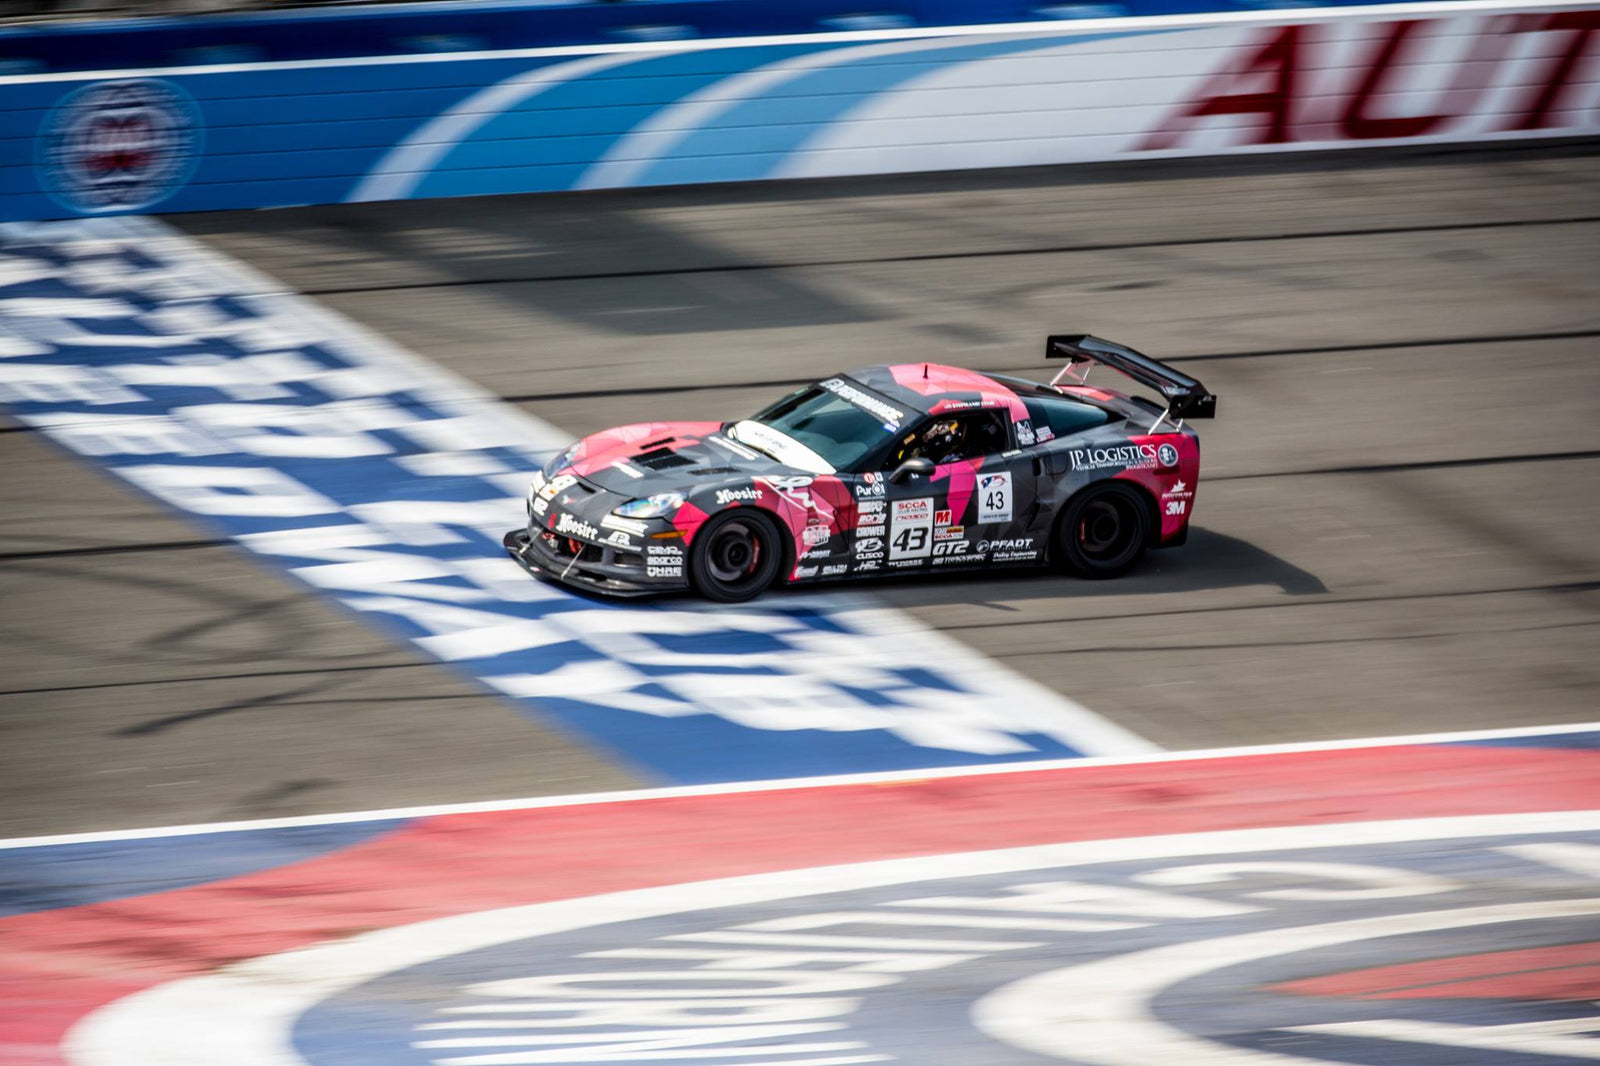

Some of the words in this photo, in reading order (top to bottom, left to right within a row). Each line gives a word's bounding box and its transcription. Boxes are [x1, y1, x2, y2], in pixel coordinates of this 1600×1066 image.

[1069, 450, 1084, 470] JP
[1086, 444, 1157, 463] LOGISTICS
[898, 501, 927, 510] SCCA
[986, 491, 1004, 510] 43
[1166, 501, 1185, 515] 3M
[892, 527, 929, 552] 43
[989, 539, 1033, 549] PFADT
[932, 540, 970, 555] GT2
